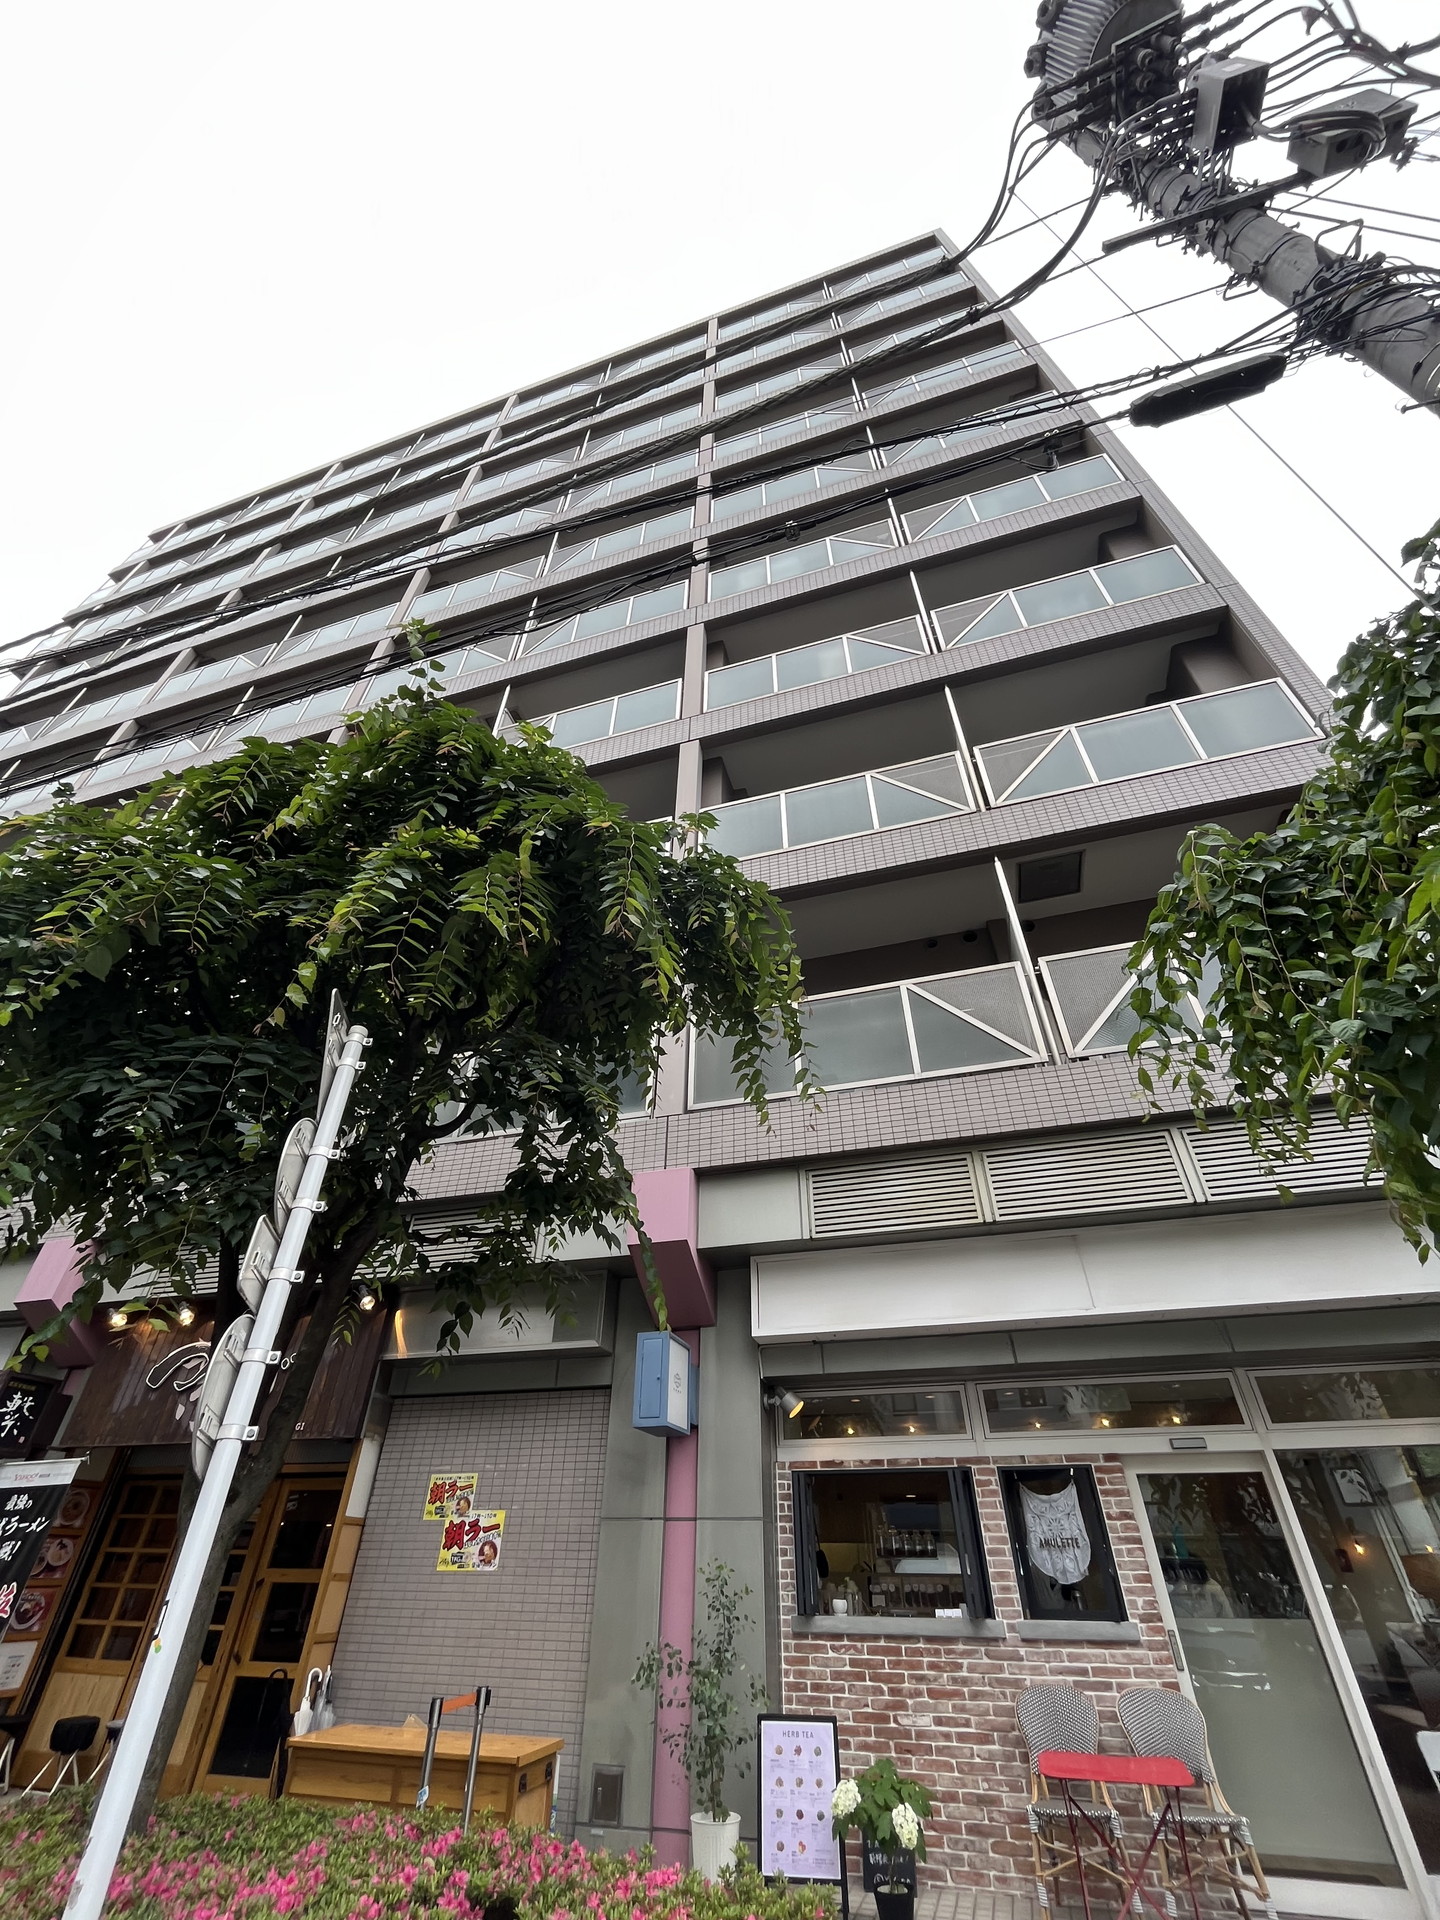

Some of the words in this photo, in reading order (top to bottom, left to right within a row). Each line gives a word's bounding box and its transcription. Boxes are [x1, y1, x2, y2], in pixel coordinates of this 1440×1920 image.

[428, 1480, 473, 1505] 朝ラー
[442, 1518, 500, 1551] 朝ラー
[1039, 1537, 1080, 1549] AMULETTE
[782, 1730, 799, 1738] HERB
[802, 1731, 814, 1739] TEA
